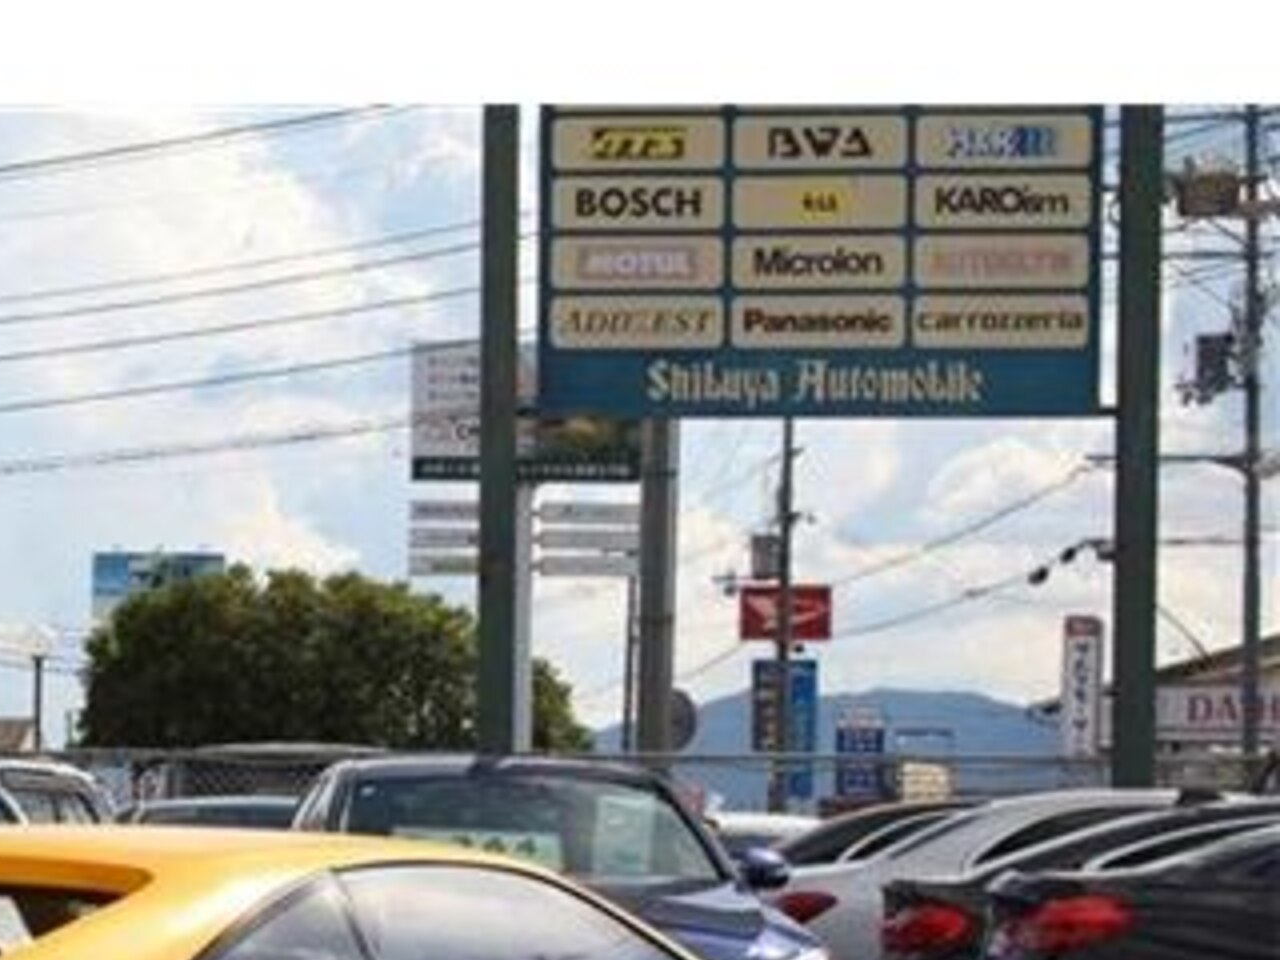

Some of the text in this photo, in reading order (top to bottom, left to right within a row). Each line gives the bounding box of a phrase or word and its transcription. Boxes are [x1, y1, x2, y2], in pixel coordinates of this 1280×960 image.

[575, 188, 702, 217] BOSCH
[753, 247, 884, 275] Microlon
[743, 308, 892, 333] Panasonic
[917, 308, 1084, 332] carrozzeria
